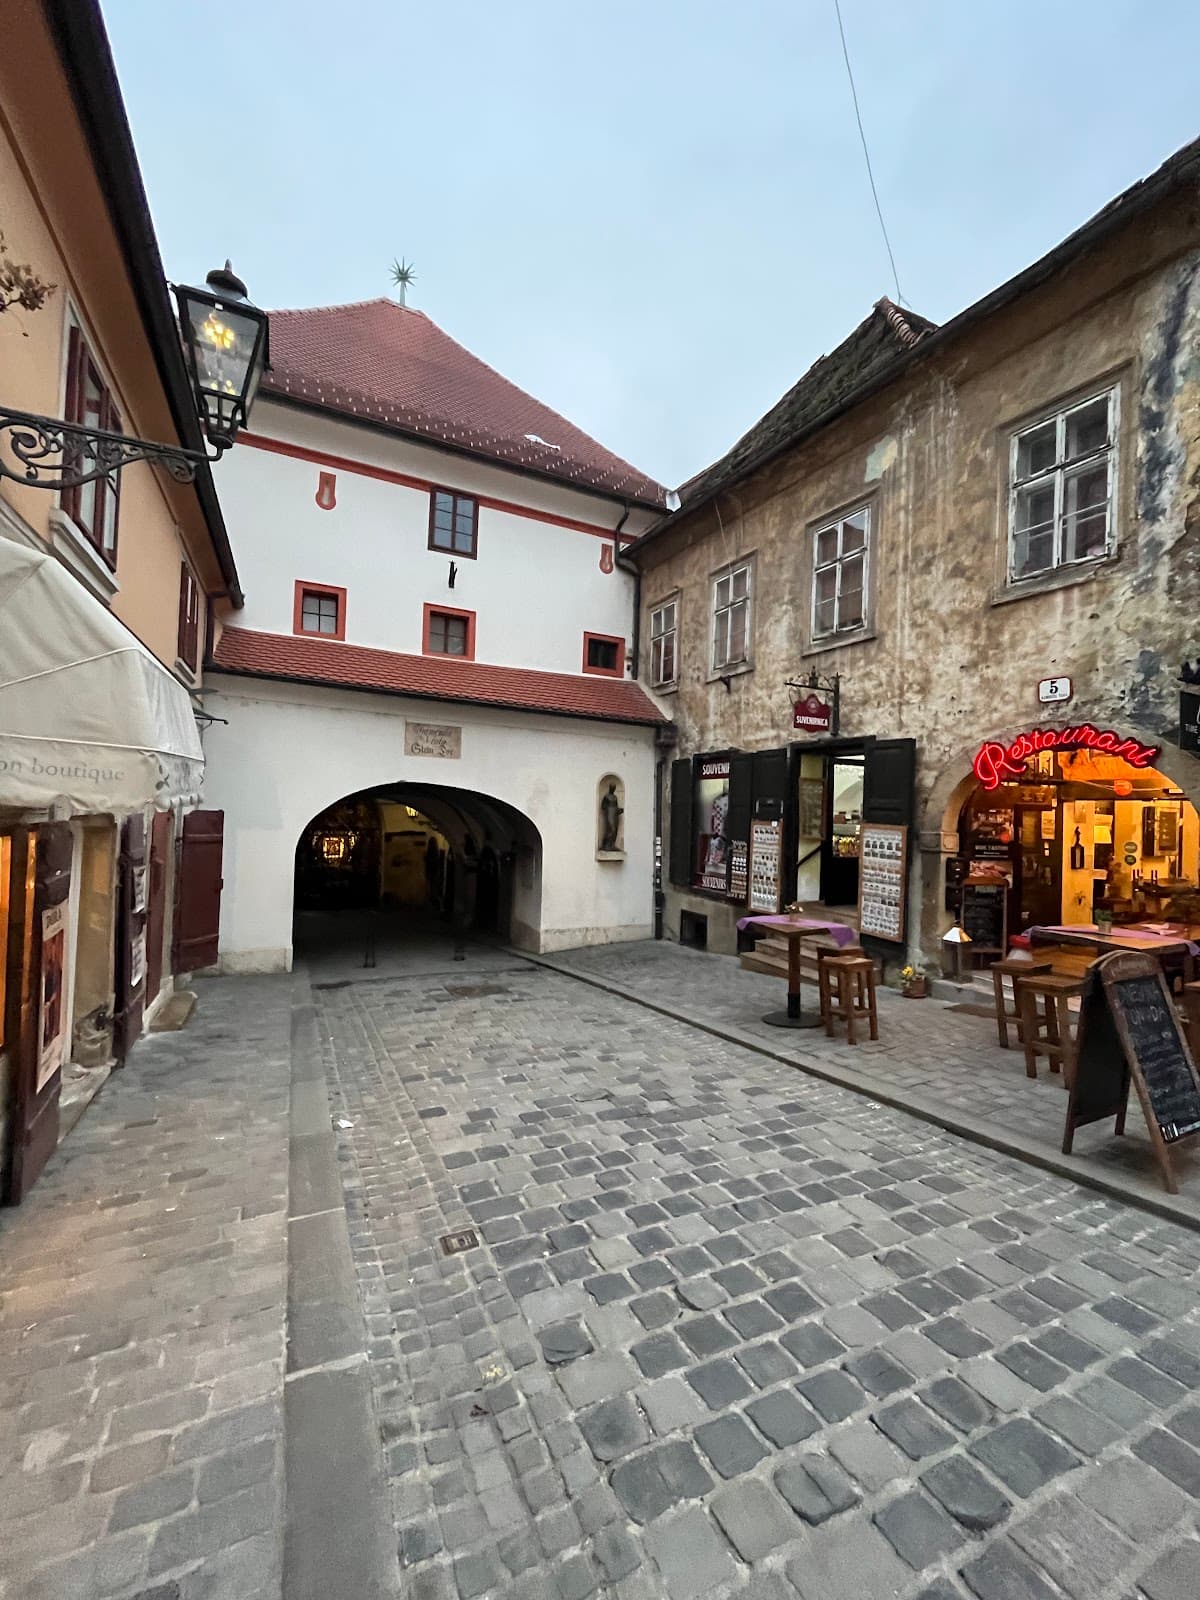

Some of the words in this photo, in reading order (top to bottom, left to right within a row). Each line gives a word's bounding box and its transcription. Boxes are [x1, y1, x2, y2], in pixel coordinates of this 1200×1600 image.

[1050, 681, 1058, 694] 5
[31, 757, 125, 784] boutique
[977, 725, 1157, 790] Restaurant
